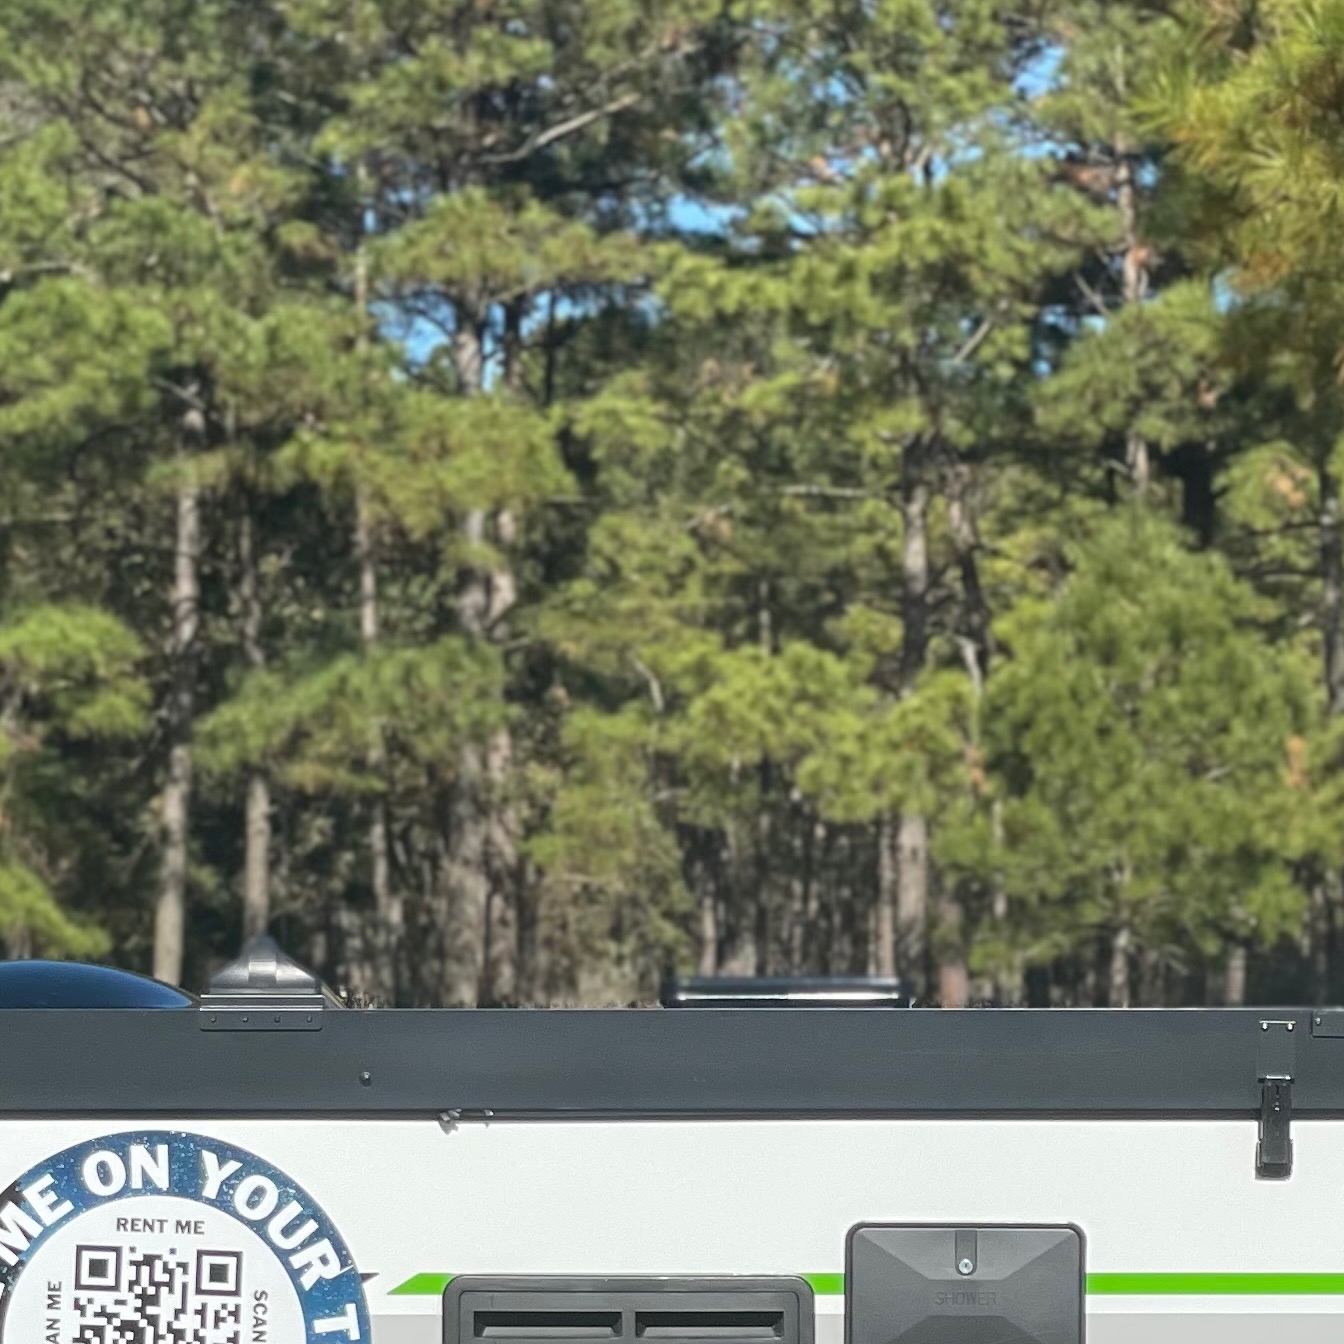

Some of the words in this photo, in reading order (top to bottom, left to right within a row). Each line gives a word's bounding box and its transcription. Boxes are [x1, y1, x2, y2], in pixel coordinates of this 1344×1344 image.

[83, 1144, 170, 1196] ON
[201, 1149, 343, 1292] YOUR
[116, 1217, 168, 1234] RENT
[175, 1220, 205, 1235] ME
[46, 1281, 62, 1310] ME
[936, 1291, 996, 1306] SHOWER
[252, 1290, 269, 1343] SCAN
